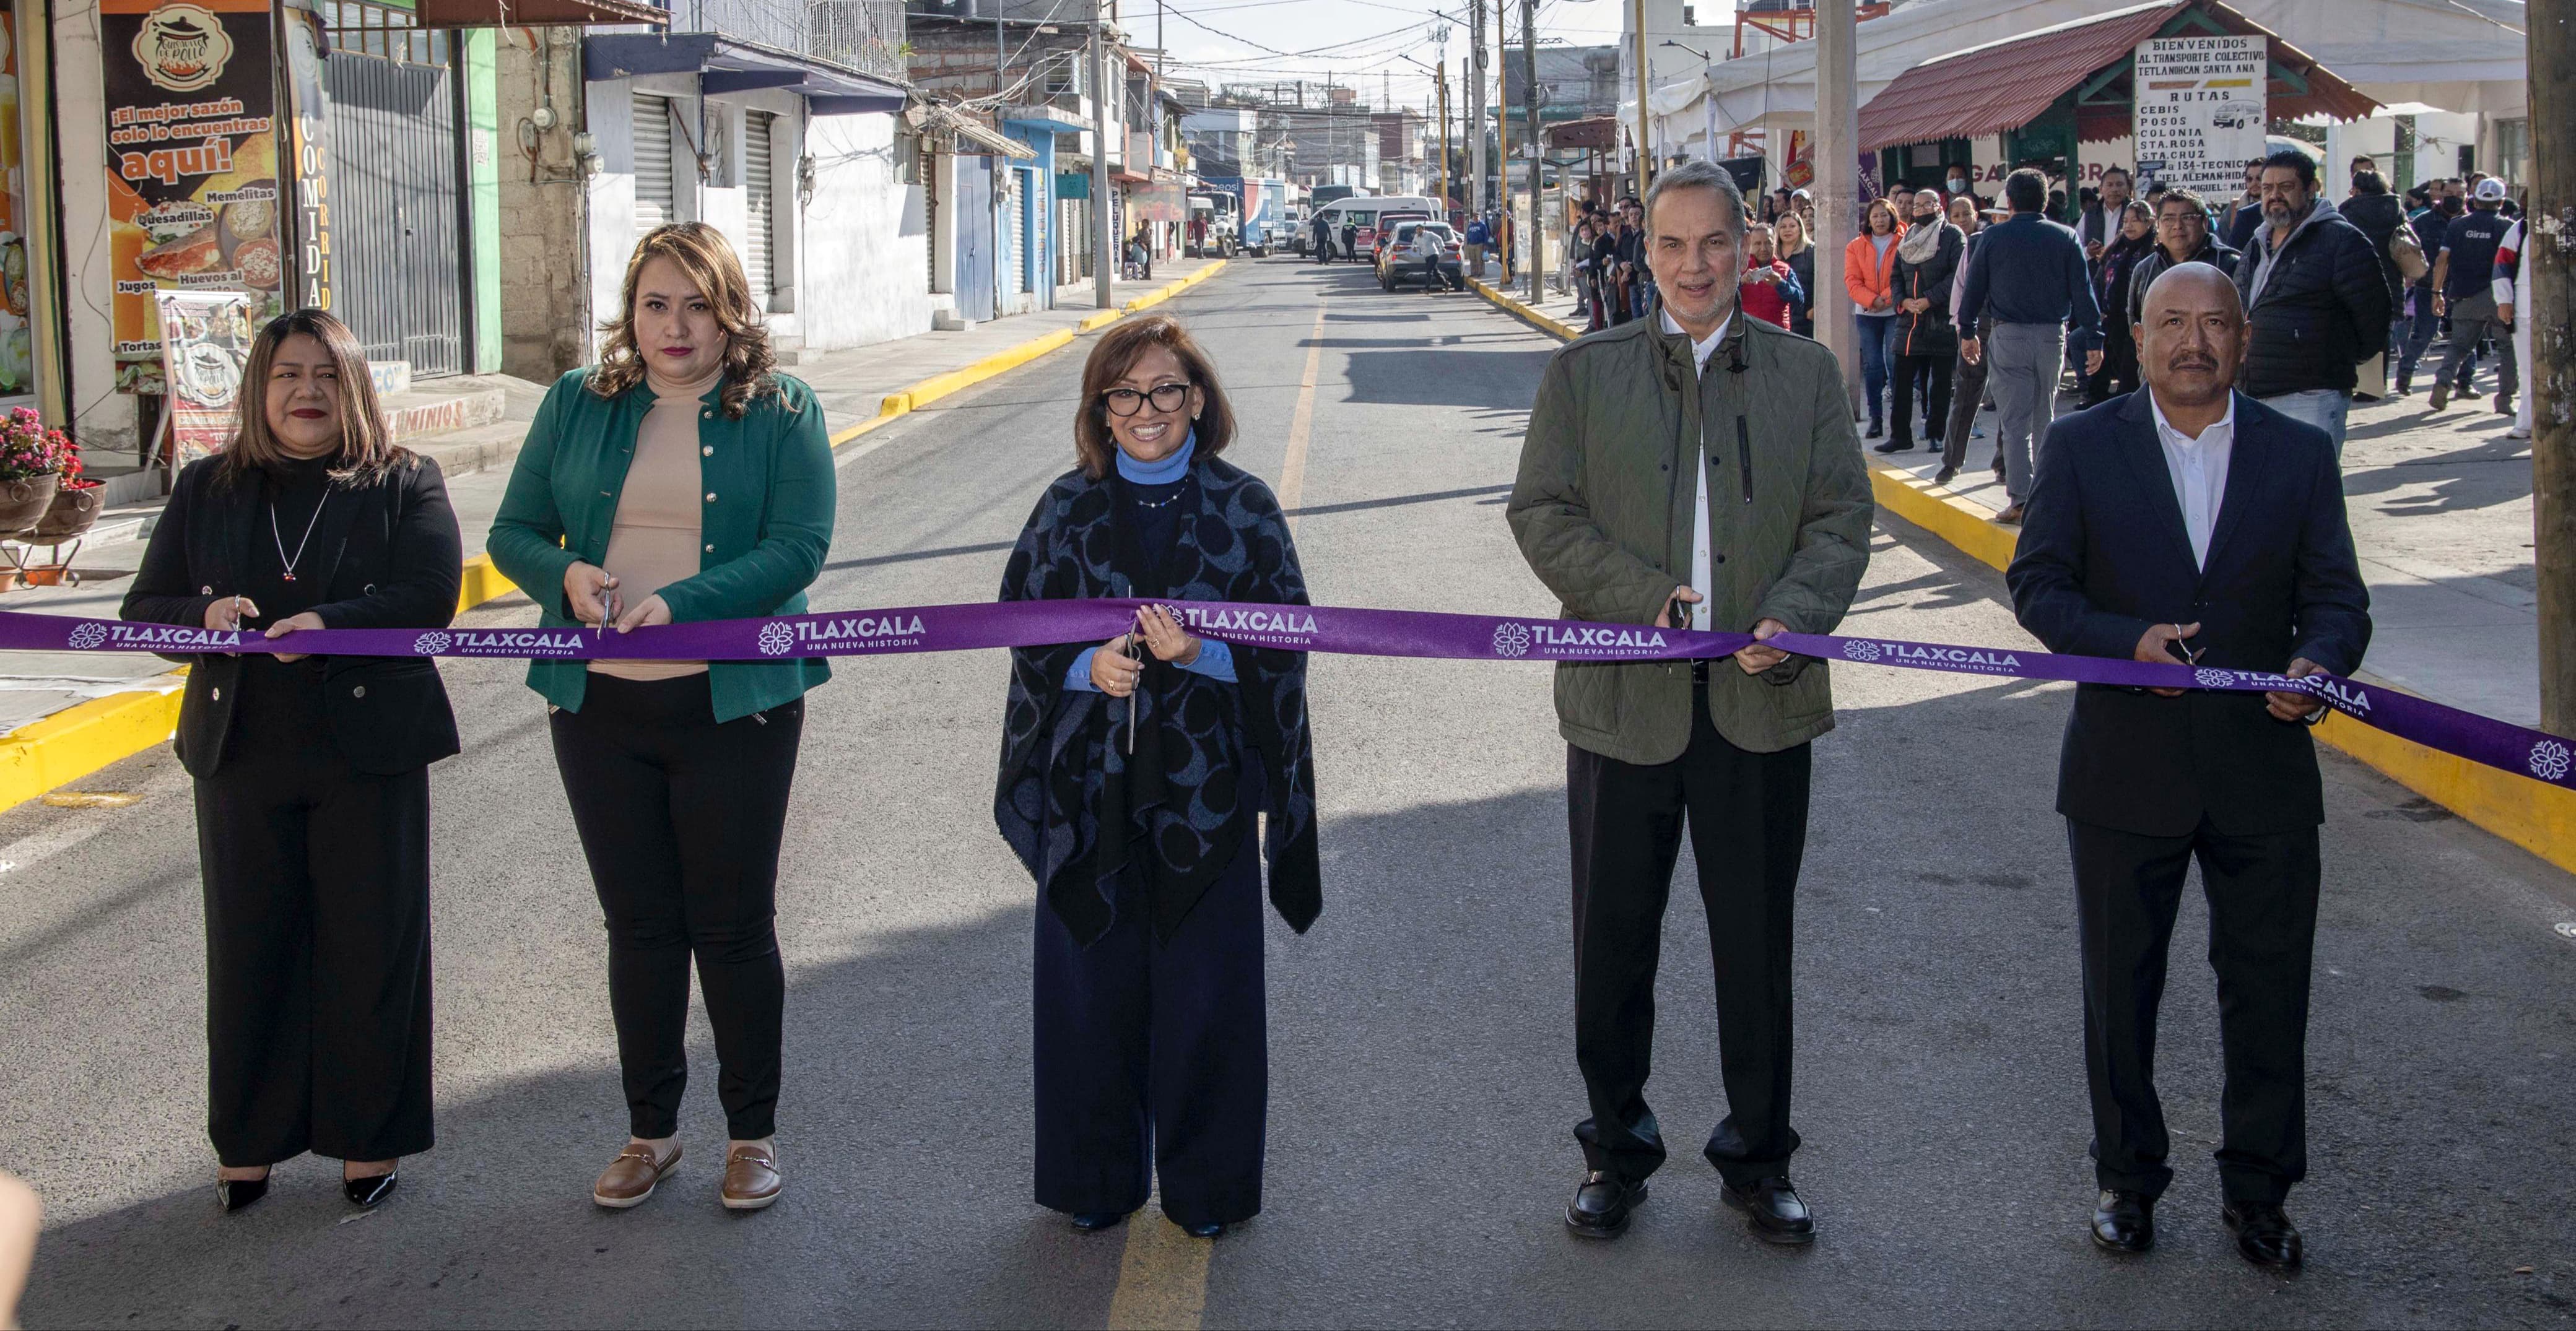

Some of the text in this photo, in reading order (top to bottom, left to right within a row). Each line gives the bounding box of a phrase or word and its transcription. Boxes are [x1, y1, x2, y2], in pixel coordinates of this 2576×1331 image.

[2152, 39, 2248, 51] BIENVENIDOS
[2139, 51, 2265, 63] AL TRANSPORTE COLECTIVO
[2138, 64, 2255, 76] TETLANOHCAN SANTA ANA
[2170, 92, 2230, 102] RUTAS
[112, 97, 242, 126] ¡El mejor sazón
[2140, 105, 2179, 115] CEBIS
[2140, 116, 2187, 126] POSOS
[111, 118, 269, 144] solo lo encuentras
[2140, 128, 2203, 137] COLONIA
[121, 137, 233, 185] aquí!
[207, 188, 275, 202] Memelitas
[301, 113, 321, 307] COMIDA
[137, 211, 212, 225] Quesadillas
[1112, 190, 1120, 264] PELUQUERIA
[2465, 230, 2491, 239] Giras
[180, 271, 242, 285] Huevos al
[118, 280, 155, 292] Jugos
[121, 342, 162, 352] Tortas
[795, 615, 926, 641] TLAXCALA
[1185, 609, 1319, 634] TLAXCALA
[111, 626, 241, 645] TLAXCALA
[455, 633, 583, 649] TLAXCALA
[1199, 629, 1311, 644] UNA NUEVA HISTORIA
[1531, 625, 1667, 648] TLAXCALA
[807, 638, 919, 651] UNA NUEVA HISTORIA
[1881, 643, 2021, 667] TLAXCALA
[1921, 660, 1956, 669] NUEVA
[1960, 664, 2015, 673] HISTORIA
[2278, 682, 2315, 694] NUEVA
[2316, 690, 2365, 717] HISTORIA
